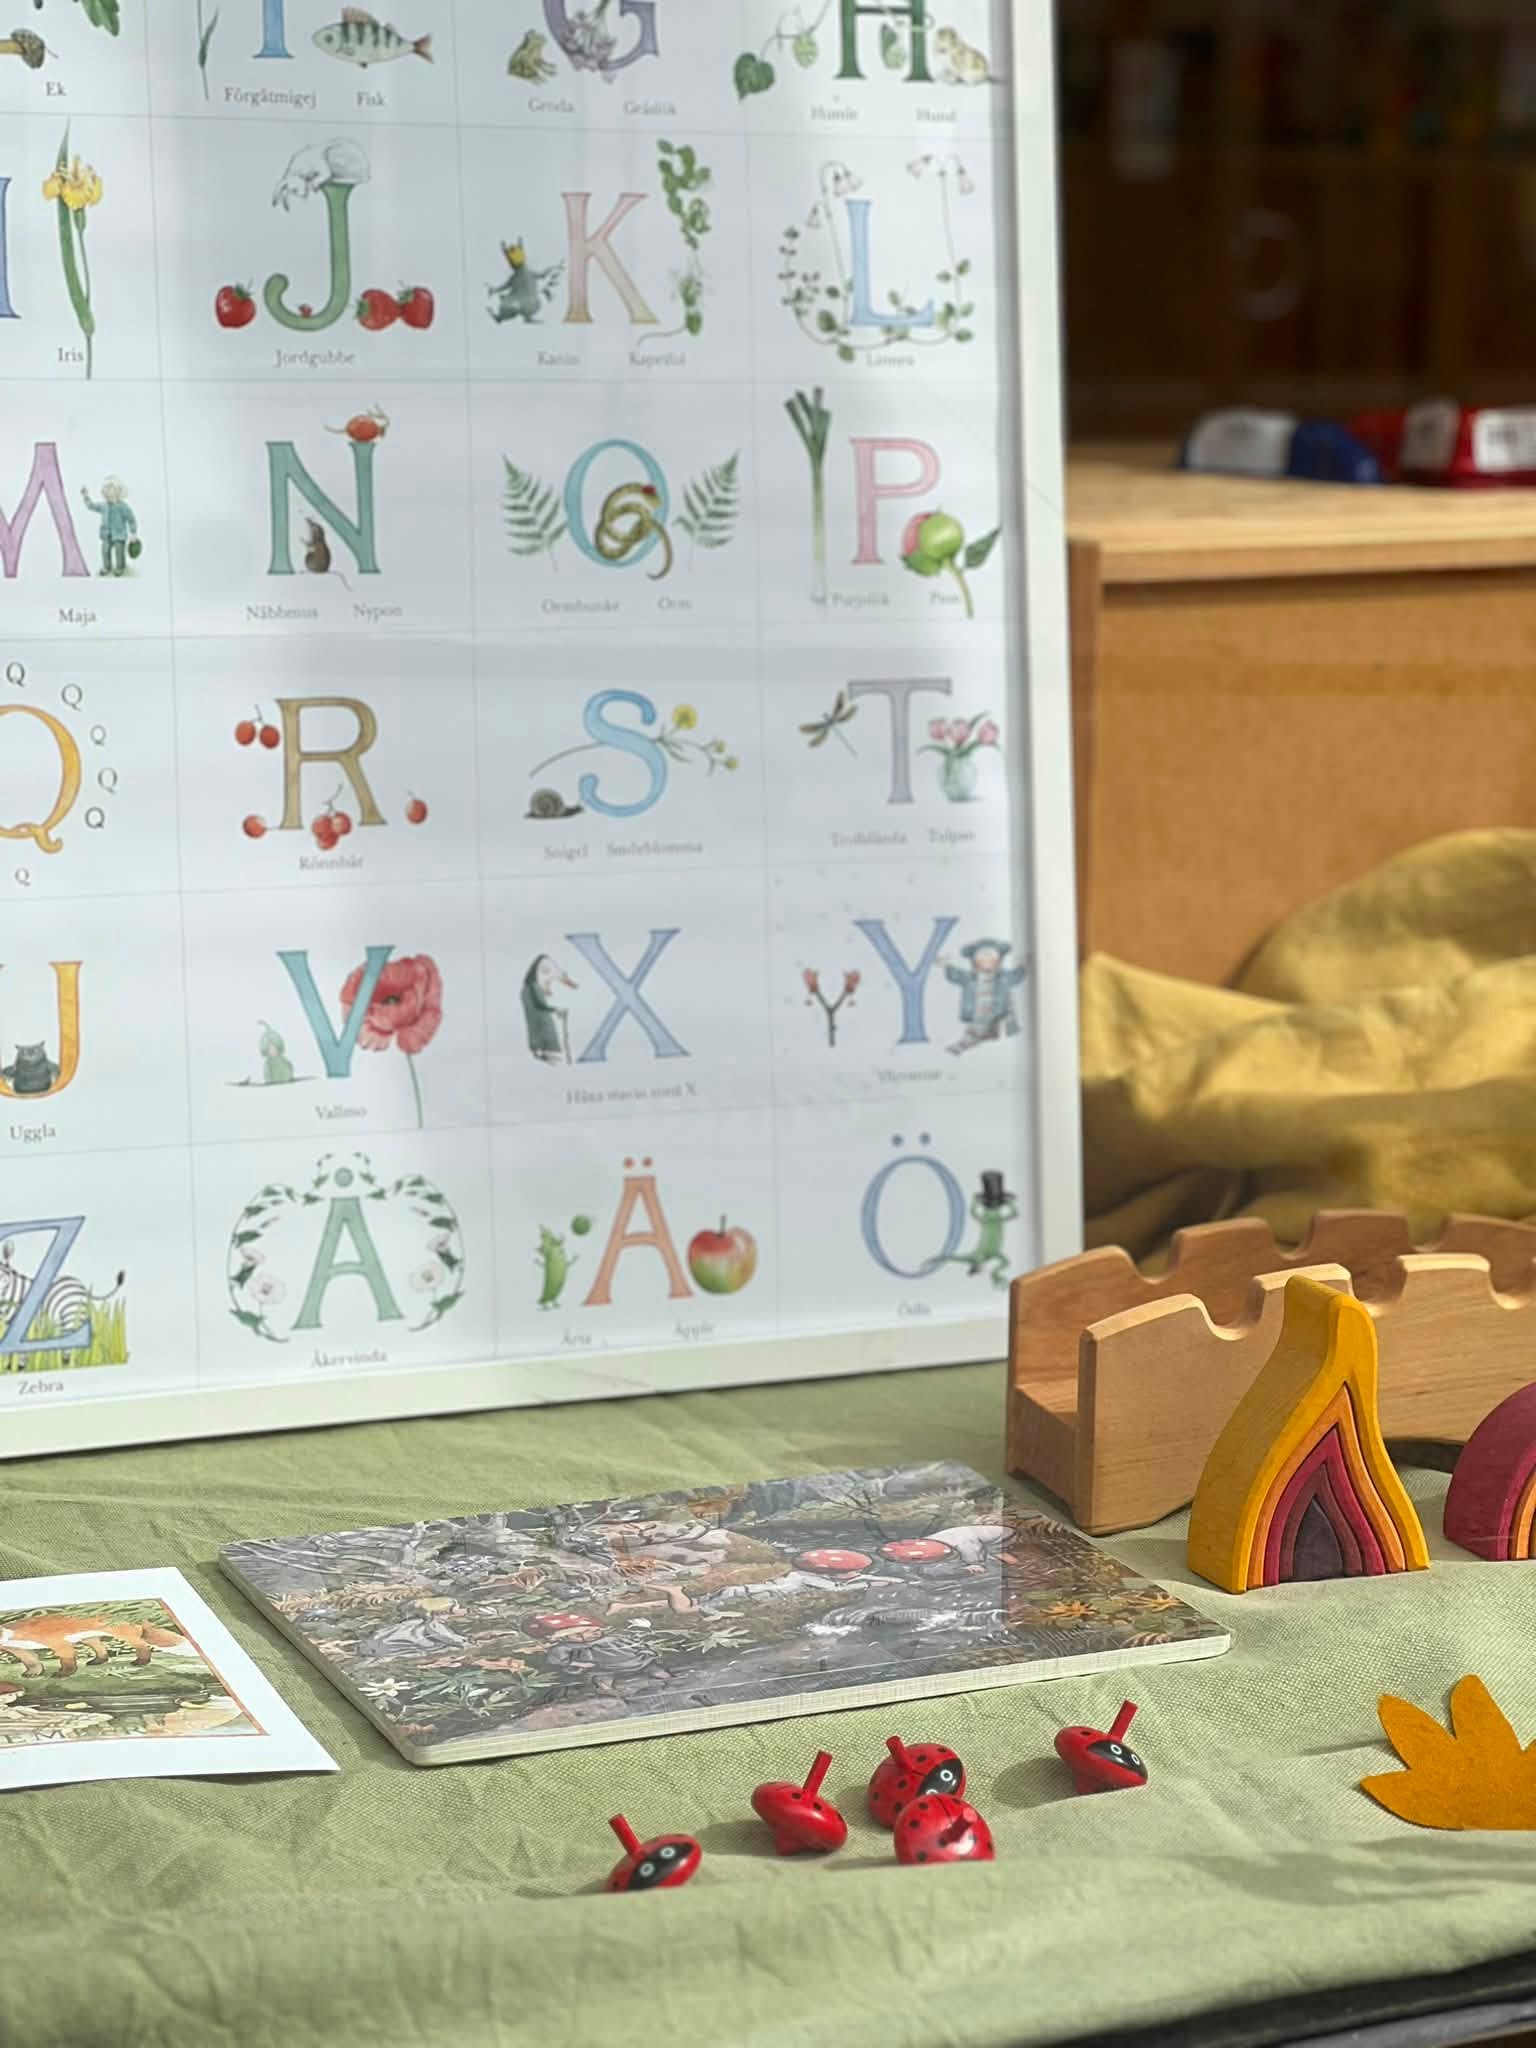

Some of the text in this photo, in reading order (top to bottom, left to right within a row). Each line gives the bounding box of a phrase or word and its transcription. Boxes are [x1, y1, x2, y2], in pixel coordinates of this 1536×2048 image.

[46, 82, 67, 97] Ek
[263, 181, 355, 332] J
[561, 192, 660, 325] K
[844, 199, 934, 327] L
[57, 347, 84, 363] Iris
[265, 441, 382, 576] N
[565, 438, 672, 567] O
[847, 437, 942, 565] P
[6, 661, 26, 687] Q
[58, 607, 97, 627] Maja
[61, 684, 83, 711] Q
[90, 724, 107, 747] Q
[578, 688, 669, 818] S
[847, 677, 953, 805] T
[84, 805, 106, 830] Q
[97, 766, 118, 793] Q
[274, 697, 387, 830] R
[14, 867, 31, 887] Q
[276, 945, 396, 1079] V
[564, 928, 692, 1064] X
[852, 917, 960, 1045] Y
[9, 1123, 57, 1143] Uggla
[582, 1156, 694, 1306] Ä
[860, 1132, 966, 1279] Ö
[0, 1215, 92, 1354] Z
[18, 1379, 64, 1395] Zebra
